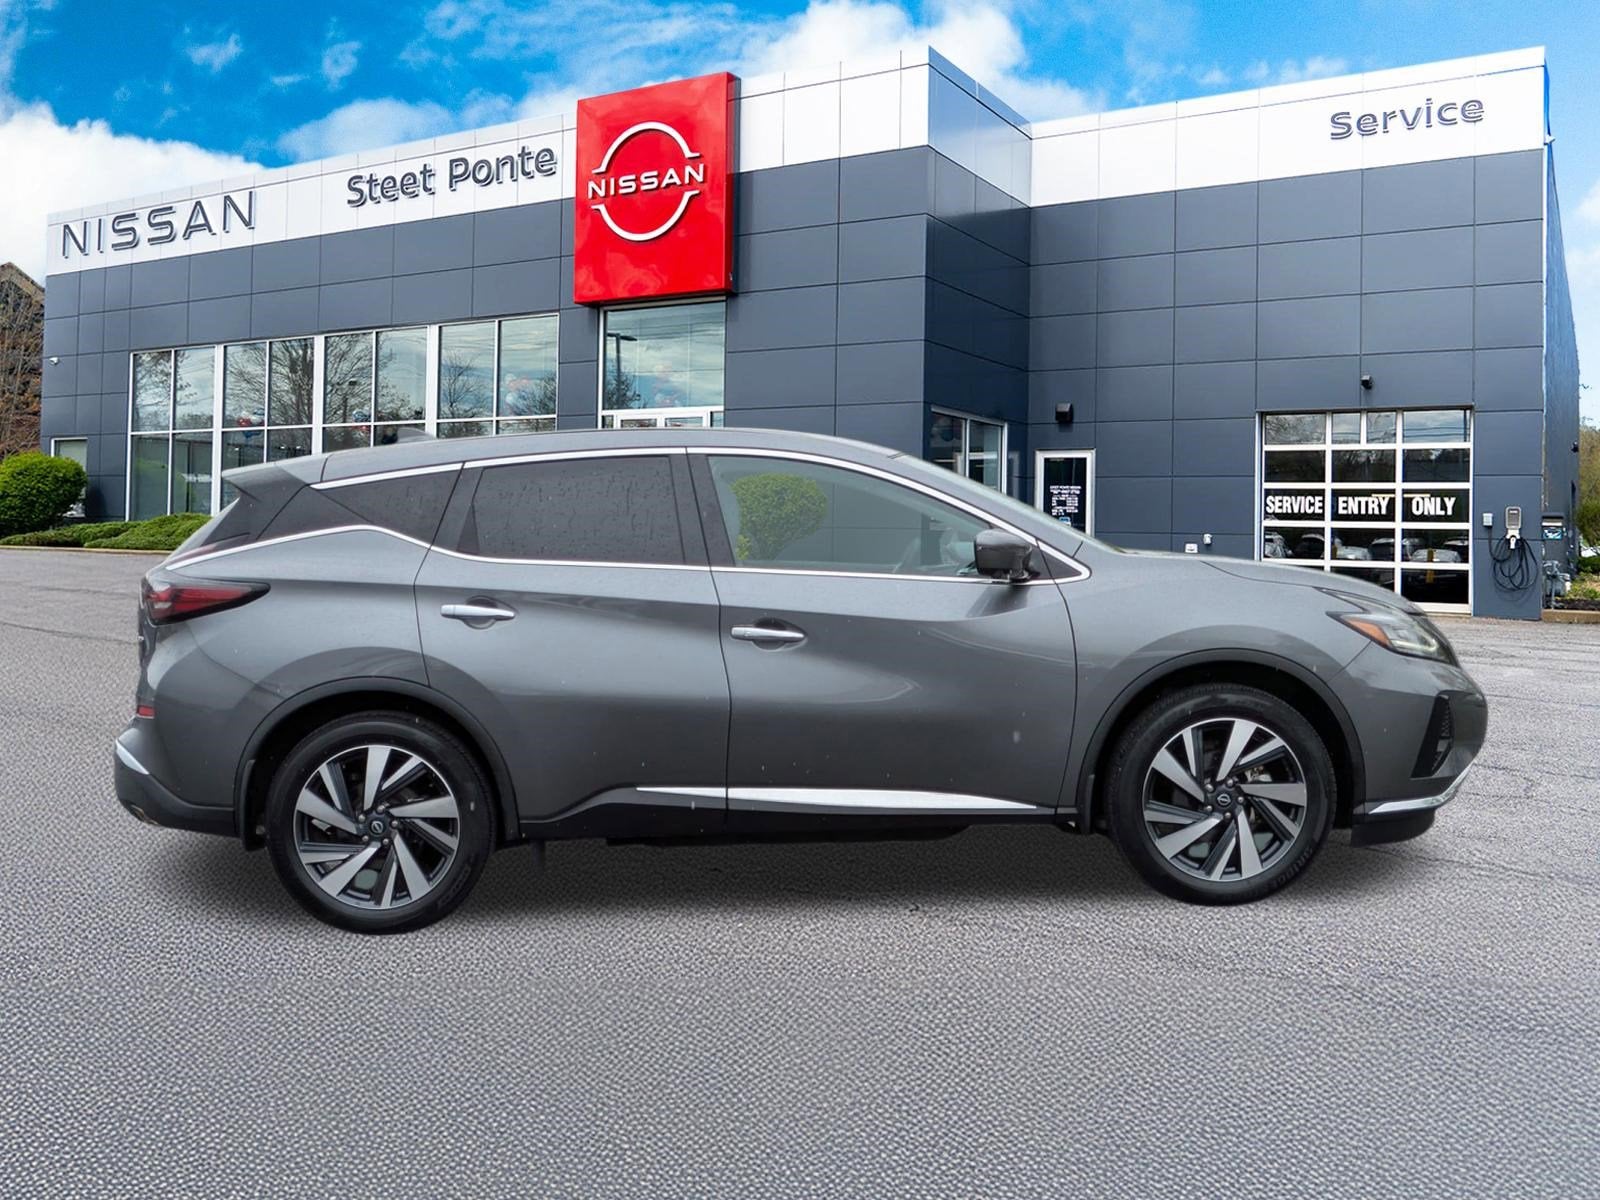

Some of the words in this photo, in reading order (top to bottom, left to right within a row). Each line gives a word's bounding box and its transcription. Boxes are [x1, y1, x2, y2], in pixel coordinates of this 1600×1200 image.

[1331, 98, 1484, 140] Service
[346, 163, 435, 207] Steet
[449, 145, 557, 191] Ponte
[587, 163, 705, 201] NISSAN
[62, 190, 256, 258] NISSAN
[1266, 495, 1323, 514] SERVICE
[1338, 496, 1390, 515] ENTRY
[1411, 496, 1456, 516] ONLY
